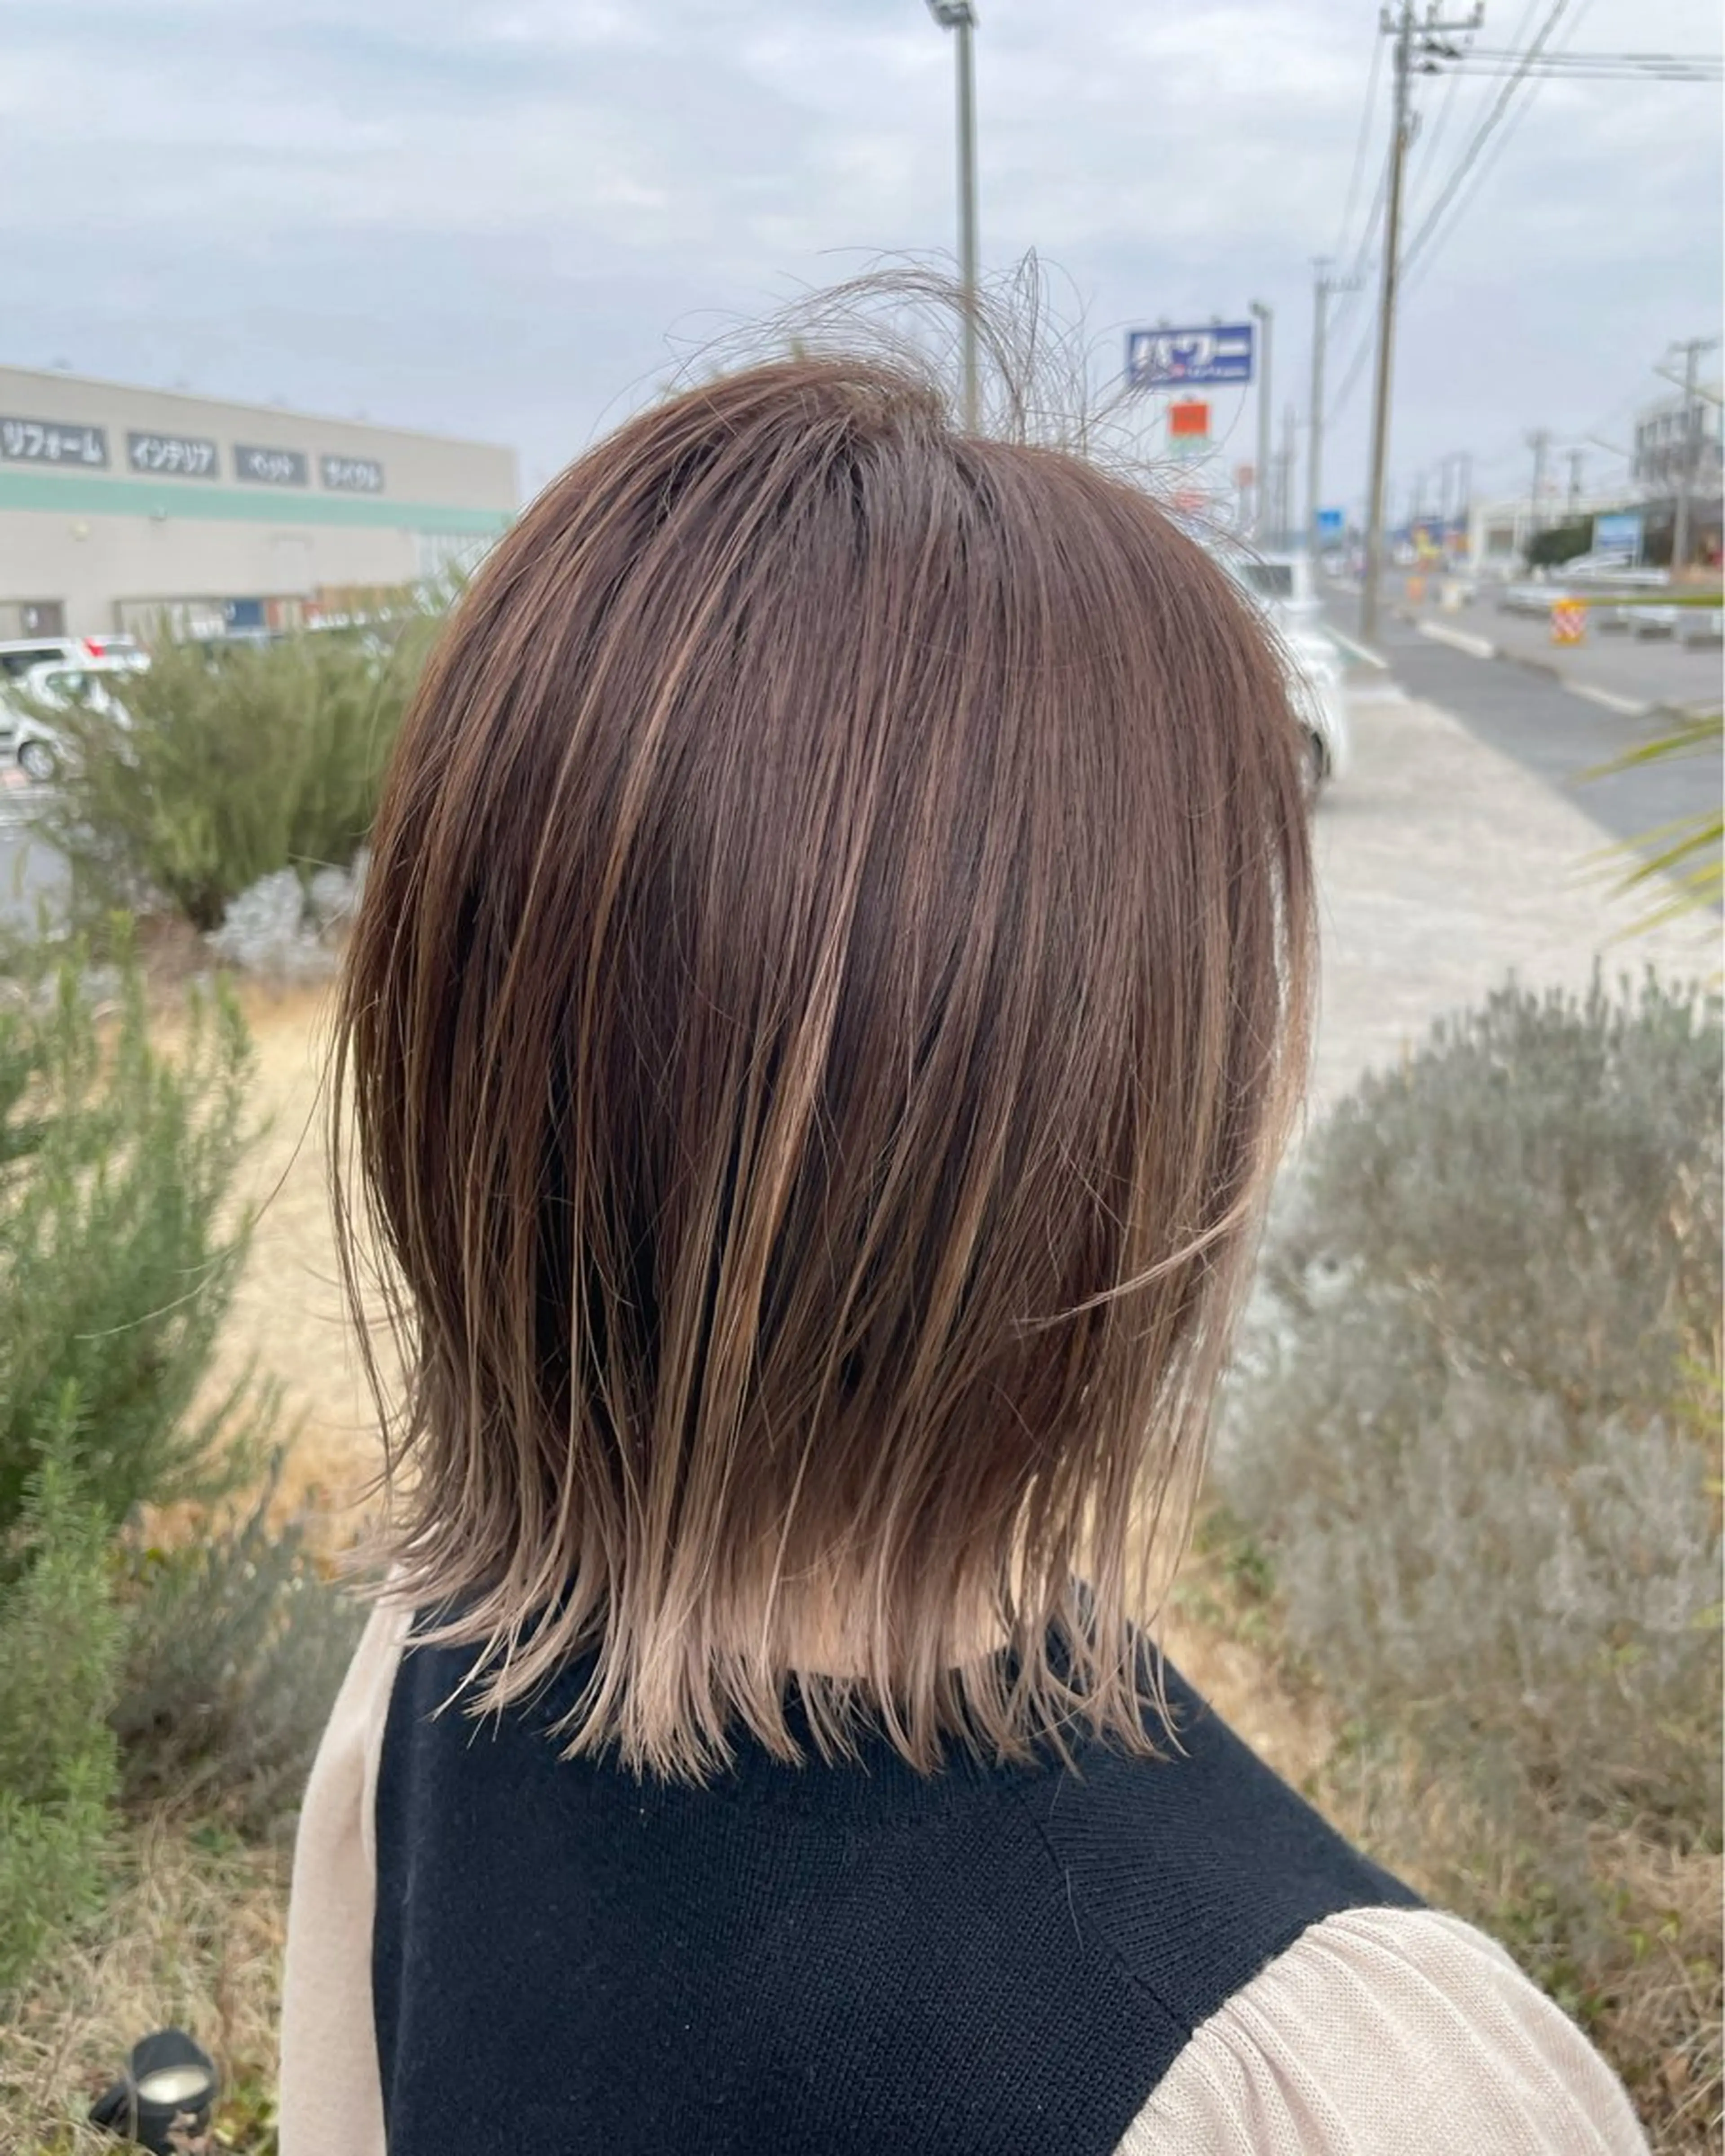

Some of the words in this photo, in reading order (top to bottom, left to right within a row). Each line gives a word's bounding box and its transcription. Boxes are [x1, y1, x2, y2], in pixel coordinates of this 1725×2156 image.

[3, 421, 102, 462] リフォーム
[133, 438, 213, 473] インテリア
